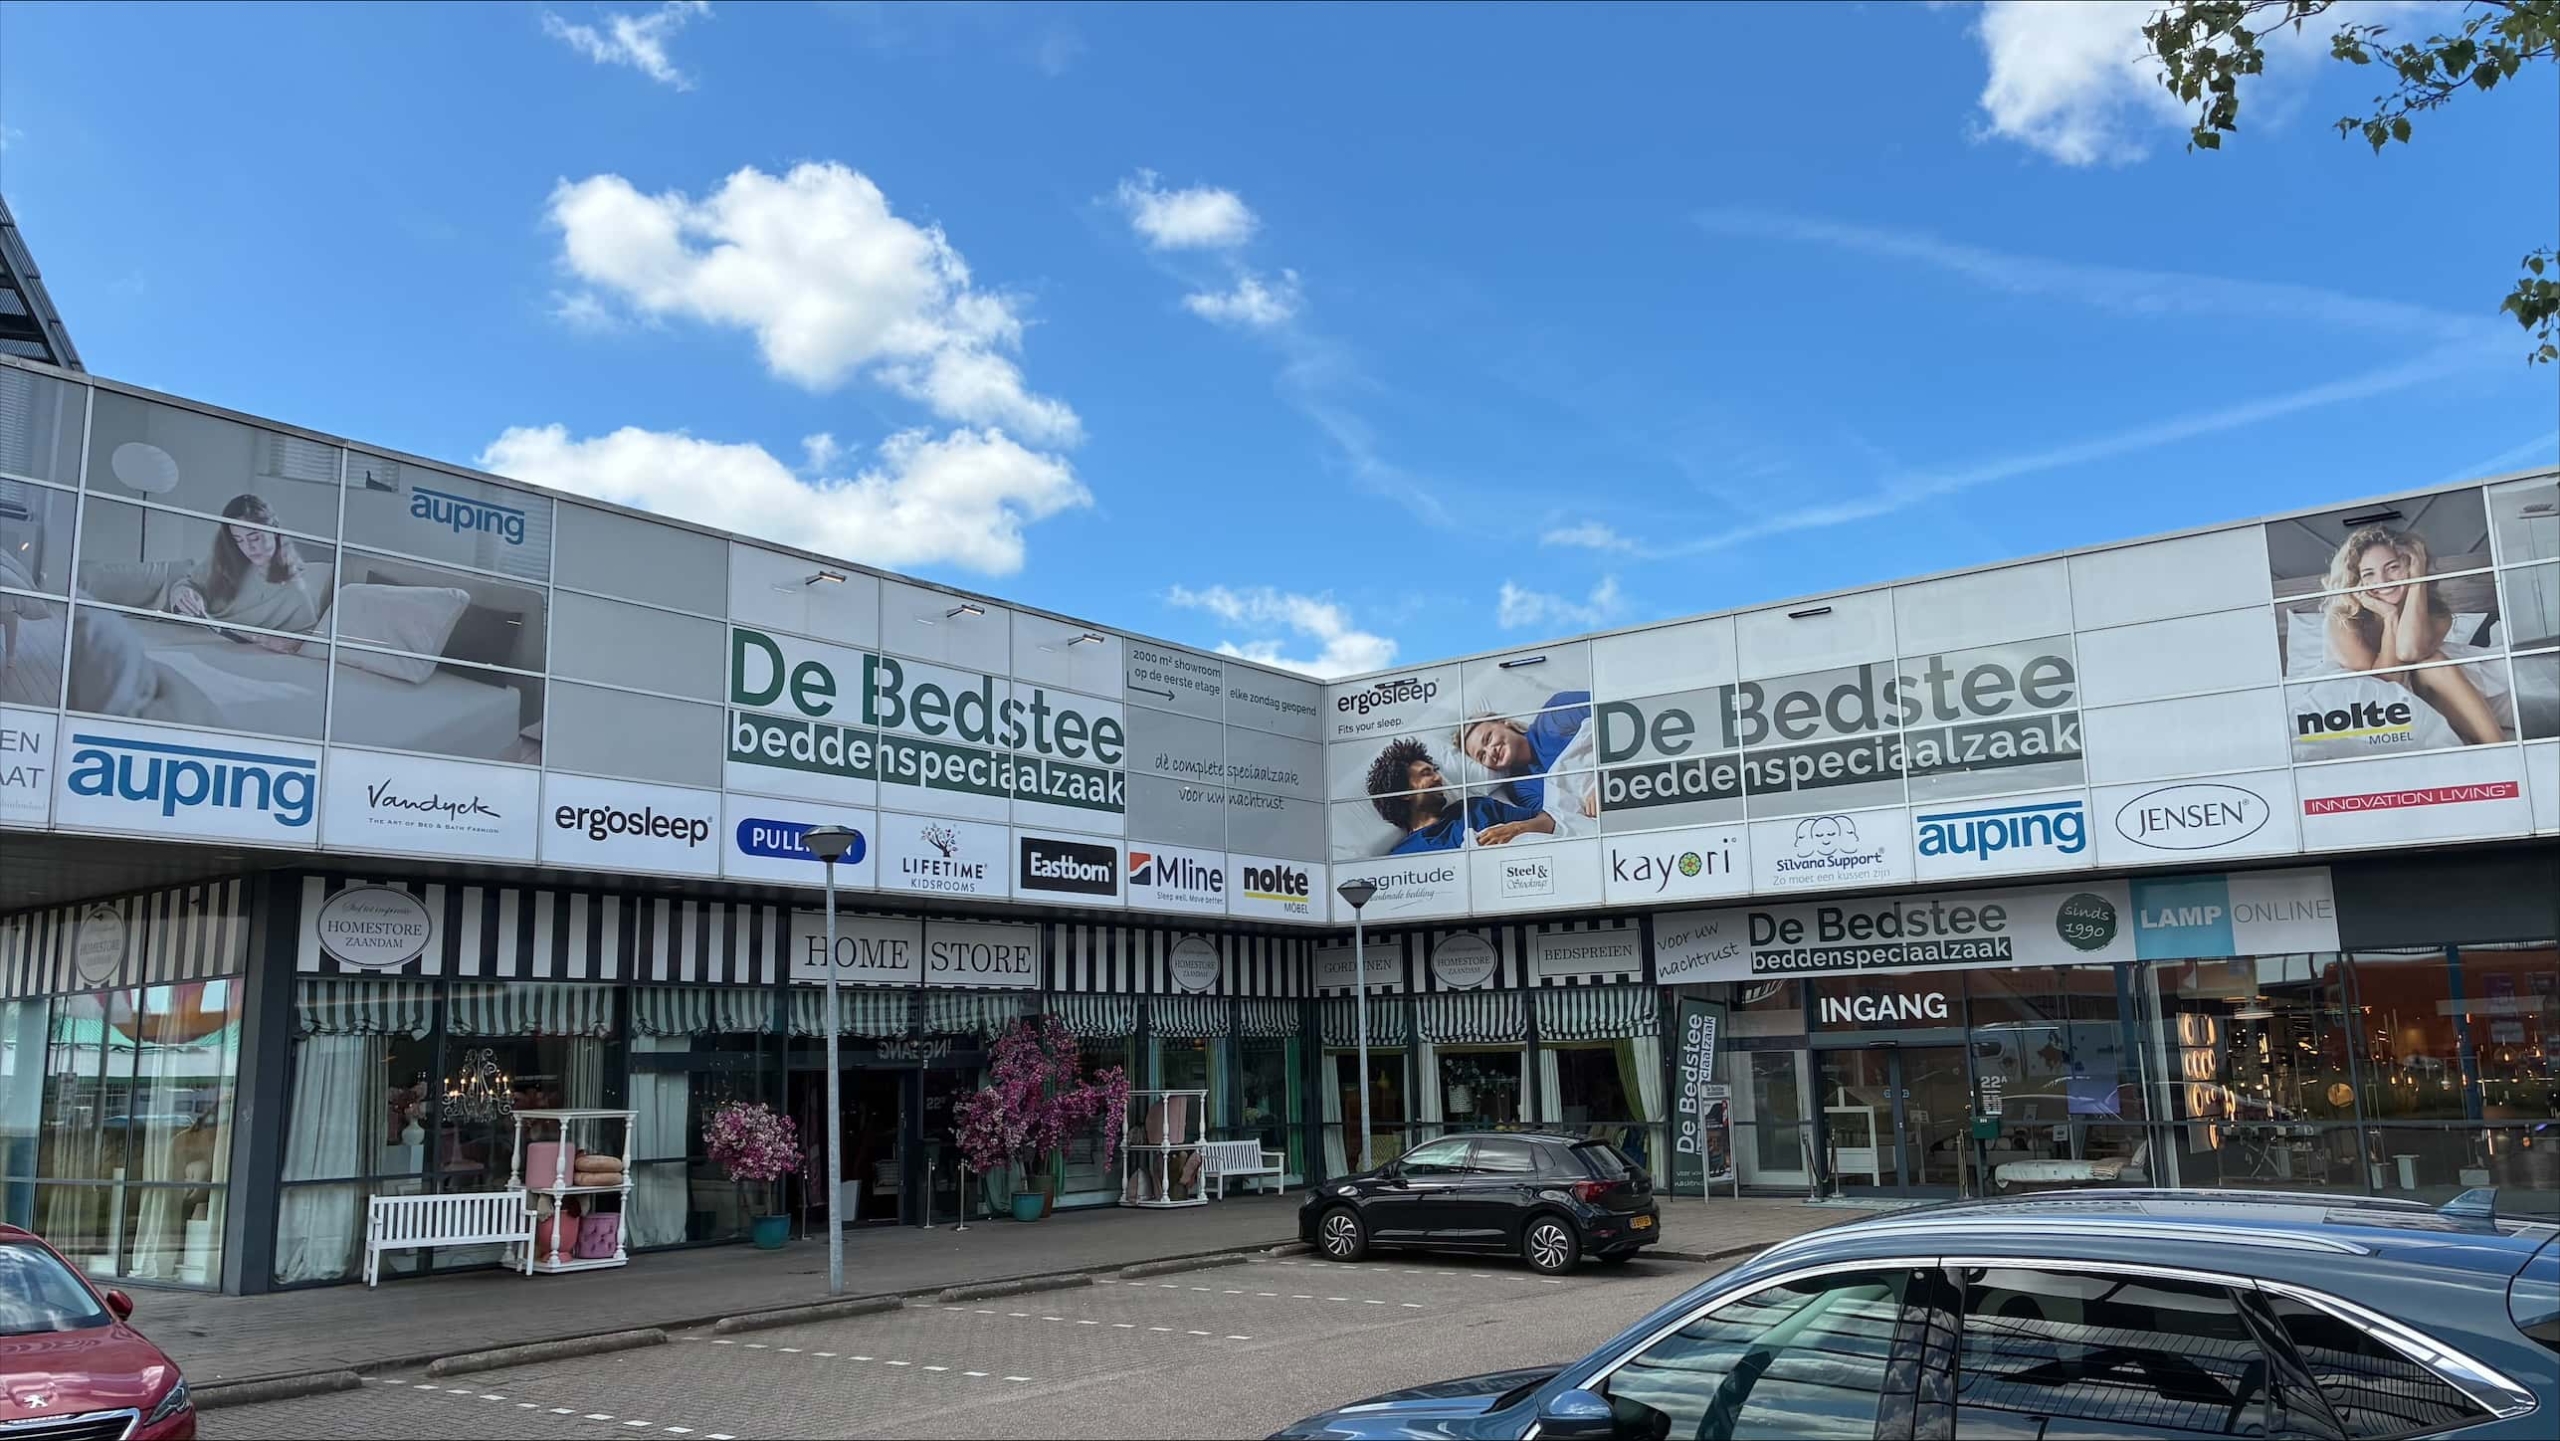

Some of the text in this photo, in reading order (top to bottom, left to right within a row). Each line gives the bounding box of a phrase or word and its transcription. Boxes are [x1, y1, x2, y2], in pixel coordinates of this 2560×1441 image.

[410, 487, 527, 545] auping
[1133, 650, 1157, 664] 2000
[1174, 659, 1221, 678] showroom
[731, 627, 1124, 764] De Bedstee
[1135, 668, 1220, 695] op de eerste etage
[1230, 688, 1316, 717] elke zondag geopend
[1338, 680, 1437, 714] ergosleep
[1599, 655, 2075, 764] De Bedstee
[1338, 718, 1404, 734] Fits your sleep.
[2299, 700, 2412, 736] nolte
[2369, 731, 2414, 746] MÖBEL
[732, 710, 1124, 806] beddenspeciaalzaak
[1173, 759, 1224, 781] complete
[1227, 763, 1299, 786] speciaalzaak
[1603, 714, 2082, 805] beddenspeciaalzaak
[0, 766, 45, 789] AT
[68, 734, 316, 828] auping
[368, 778, 501, 821] Vandyck
[1179, 788, 1285, 810] voor uw nachtrust
[2311, 784, 2506, 813] INNOVATION LIVING
[555, 805, 709, 847] ergosleep
[1917, 800, 2086, 861] auping
[2139, 801, 2244, 838] JENSEN
[753, 827, 852, 857] PULL
[903, 856, 983, 880] LIFETIME
[1030, 851, 1109, 883] Eastborn
[1157, 854, 1223, 893] Mline
[1507, 864, 1548, 879] Steel &
[1613, 838, 1731, 892] kayori
[1773, 868, 1890, 886] Zo moet een kussen zijn
[1777, 853, 1883, 872] Silvana Support
[910, 877, 975, 893] KIDSROOMS
[1244, 865, 1308, 896] nolte
[1348, 867, 1454, 891] agnitude
[1405, 887, 1435, 900] bedding
[1157, 892, 1173, 902] Sleep
[1189, 894, 1204, 903] Move
[1206, 895, 1224, 905] better.
[1284, 902, 1309, 914] MÖBEL
[2065, 904, 2109, 921] sinds
[328, 920, 422, 936] HOMESTORE
[1749, 900, 2007, 946] De Bedstee
[2141, 899, 2333, 929] LAMP ONLINE
[345, 937, 403, 948] ZAANDAM
[1657, 922, 1718, 950] voor uw
[2065, 922, 2105, 940] 1990
[804, 936, 1031, 974] HOME STORE
[1175, 959, 1217, 971] HOMESTORE
[1437, 956, 1491, 967] HOMESTORE
[1544, 944, 1633, 961] BEDSPREIEN
[1658, 942, 1740, 978] nachtrust
[1752, 937, 2011, 970] beddenspeciaalzaak
[1820, 992, 1949, 1024] INGANG
[1677, 1014, 1702, 1154] De Bedstee
